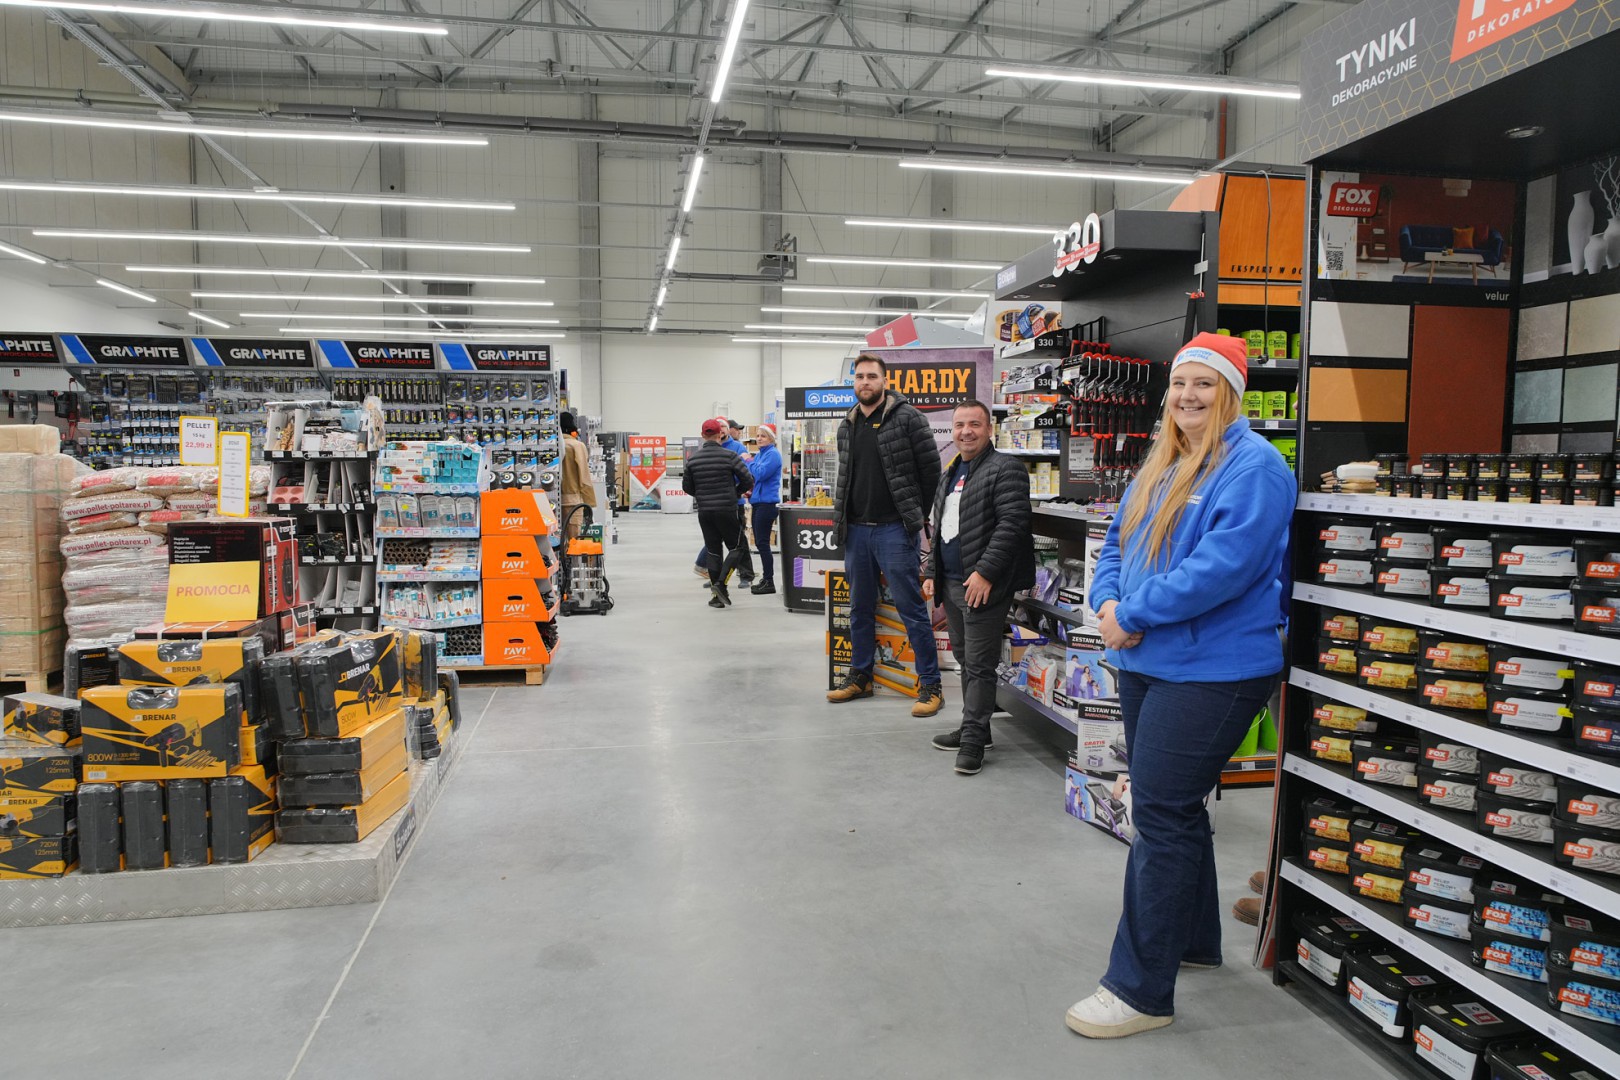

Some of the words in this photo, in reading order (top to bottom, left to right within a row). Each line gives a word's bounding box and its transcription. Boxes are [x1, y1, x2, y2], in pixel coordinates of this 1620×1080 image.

[1335, 17, 1417, 83] TYNKI
[1331, 54, 1418, 108] DEKORACYJNE
[1334, 187, 1373, 205] FOX
[1052, 212, 1100, 278] 330
[1485, 291, 1510, 301] velur
[1038, 338, 1054, 346] 330
[101, 345, 180, 358] GRAPHITE
[229, 348, 306, 361] GRAPHITE
[357, 347, 431, 359] GRAPHITE
[477, 350, 547, 361] GRAPHITE
[885, 368, 971, 394] HARDY
[822, 394, 854, 404] Dolphin
[186, 422, 211, 430] PELLET
[1038, 418, 1053, 426] 330
[1383, 538, 1399, 546] FOX
[1590, 563, 1616, 573] FOX
[175, 584, 252, 597] PROMOCJA
[1500, 595, 1519, 603] FOX
[1586, 607, 1612, 617] FOX
[1326, 621, 1341, 629] FOX
[1071, 636, 1096, 644] ZESTAW
[1365, 632, 1382, 640] FOX
[1429, 649, 1447, 657] FOX
[172, 665, 202, 674] BRENAR
[346, 663, 371, 680] BRENAR
[1498, 663, 1518, 671] FOX
[1427, 686, 1445, 694] FOX
[1587, 682, 1610, 692] FOX
[1084, 706, 1110, 714] ZESTAW
[1496, 703, 1515, 711] FOX
[142, 713, 177, 722] BRENAR
[1585, 727, 1608, 737] FOX
[88, 753, 114, 762] 800W
[1428, 749, 1446, 758] FOX
[1359, 762, 1377, 771] FOX
[1489, 774, 1511, 783] FOX
[1425, 785, 1444, 794] FOX
[8, 798, 38, 806] BRENAR
[1571, 801, 1595, 812] FOX
[1311, 819, 1327, 828] FOX
[1487, 814, 1509, 824] FOX
[1355, 843, 1374, 853] FOX
[1567, 843, 1591, 854] FOX
[1310, 851, 1327, 860] FOX
[1355, 877, 1373, 887] FOX
[1411, 873, 1430, 882] FOX
[1411, 909, 1429, 918] FOX
[1486, 908, 1508, 920] FOX
[1486, 949, 1508, 960] FOX
[1574, 950, 1600, 962] FOX
[1562, 990, 1588, 1002] FOX
[1415, 1032, 1431, 1047] FOX
